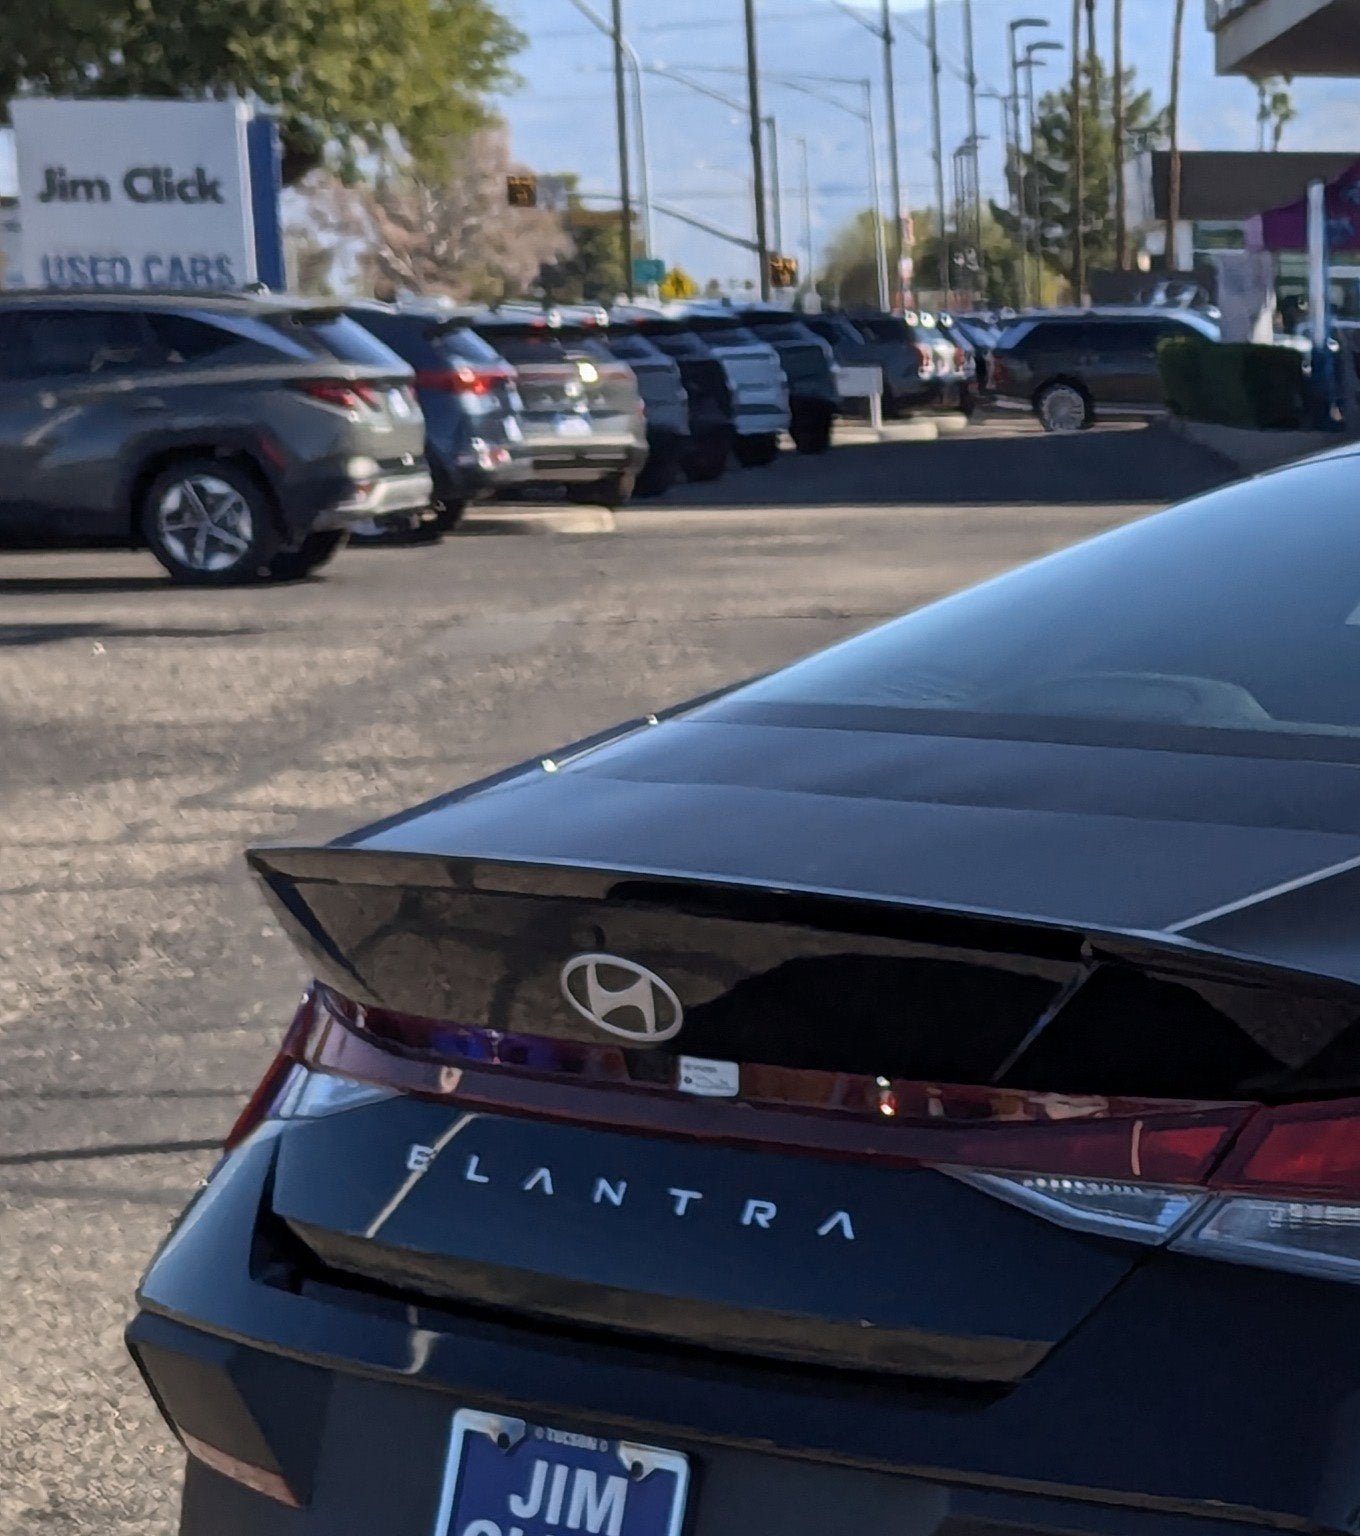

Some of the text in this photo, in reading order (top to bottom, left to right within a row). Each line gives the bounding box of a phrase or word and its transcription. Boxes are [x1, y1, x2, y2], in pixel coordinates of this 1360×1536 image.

[40, 166, 225, 204] Jim Click
[41, 254, 236, 287] USED CARS
[406, 1144, 856, 1241] ELANTRA
